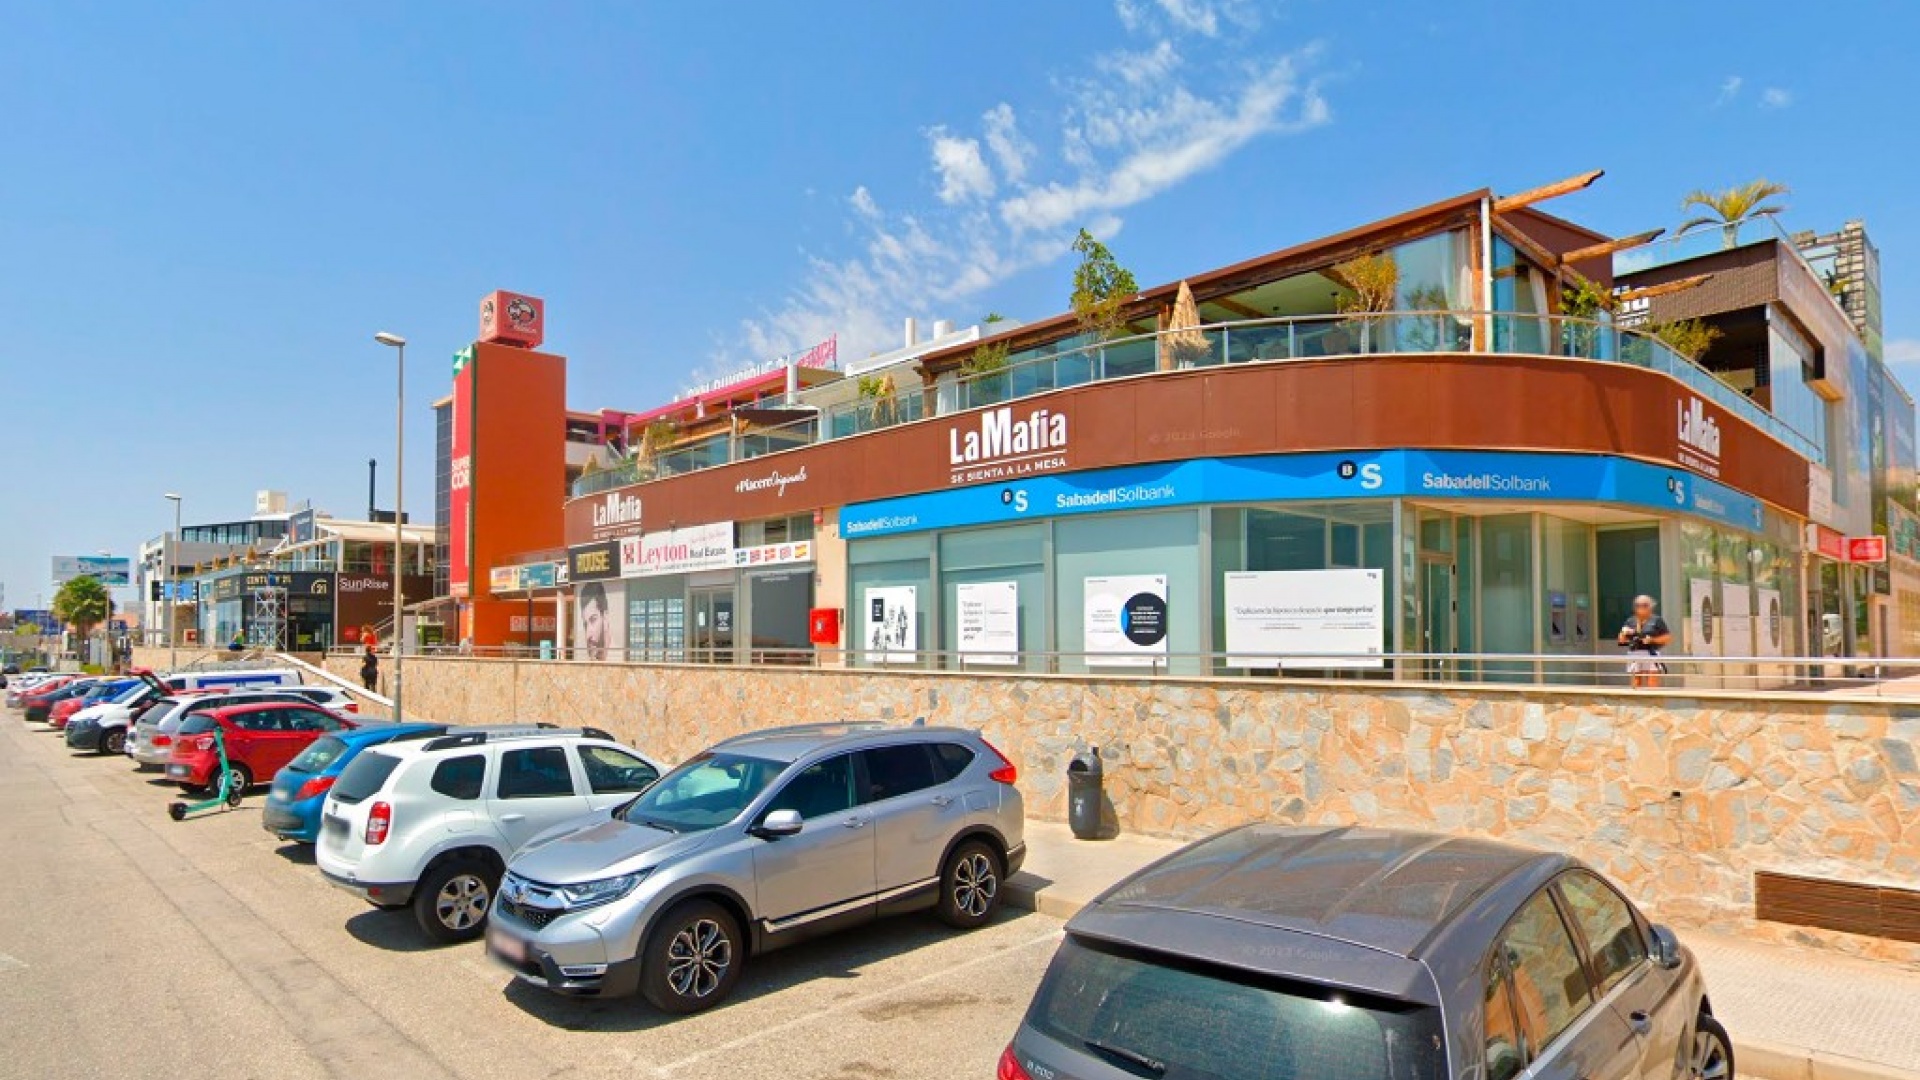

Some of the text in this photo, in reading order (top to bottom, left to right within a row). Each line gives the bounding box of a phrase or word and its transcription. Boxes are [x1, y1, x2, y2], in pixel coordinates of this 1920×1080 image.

[950, 456, 1066, 484] SE SIENTA A LA MESA
[1360, 463, 1383, 490] S
[1422, 472, 1551, 492] SabadellSolbank
[1014, 489, 1028, 512] S
[1056, 484, 1175, 508] SabadellSolbank
[637, 540, 687, 571] Leyton
